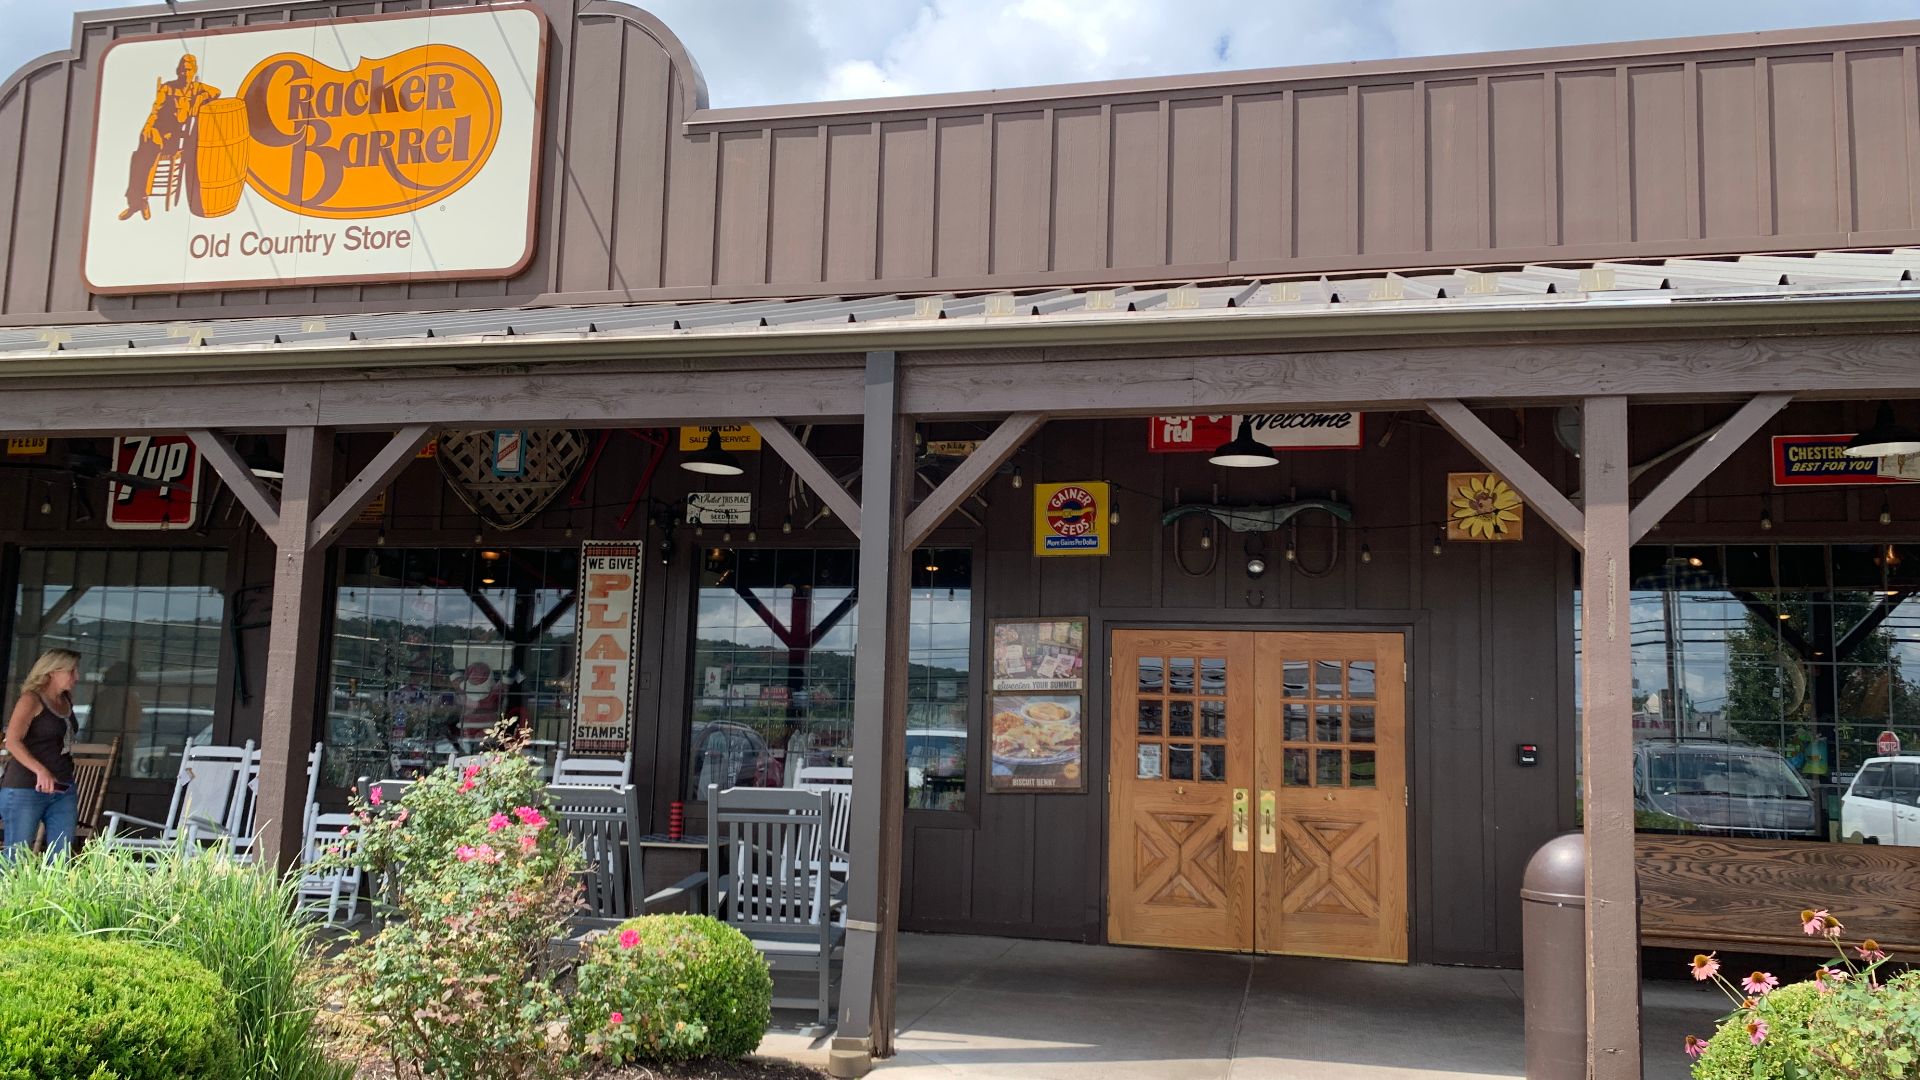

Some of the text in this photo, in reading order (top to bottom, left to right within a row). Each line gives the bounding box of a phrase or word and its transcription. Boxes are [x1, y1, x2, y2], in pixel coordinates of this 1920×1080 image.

[189, 225, 411, 259] Old Country Store
[1163, 420, 1192, 443] red
[1788, 446, 1858, 461] CHESTER
[1792, 462, 1821, 472] BEST
[1822, 462, 1845, 471] FOR
[1849, 461, 1873, 471] YOU
[722, 496, 734, 504] THIS
[734, 496, 749, 504] PLACE
[1051, 489, 1092, 508] GAINER
[1053, 519, 1090, 536] FEEDS
[589, 558, 633, 570] WE GIVE
[581, 573, 633, 724] PLAID
[1032, 681, 1048, 689] YOUR
[1050, 681, 1077, 689] SUMMER
[578, 726, 624, 739] STAMPS
[1012, 778, 1034, 786] BISCUIT
